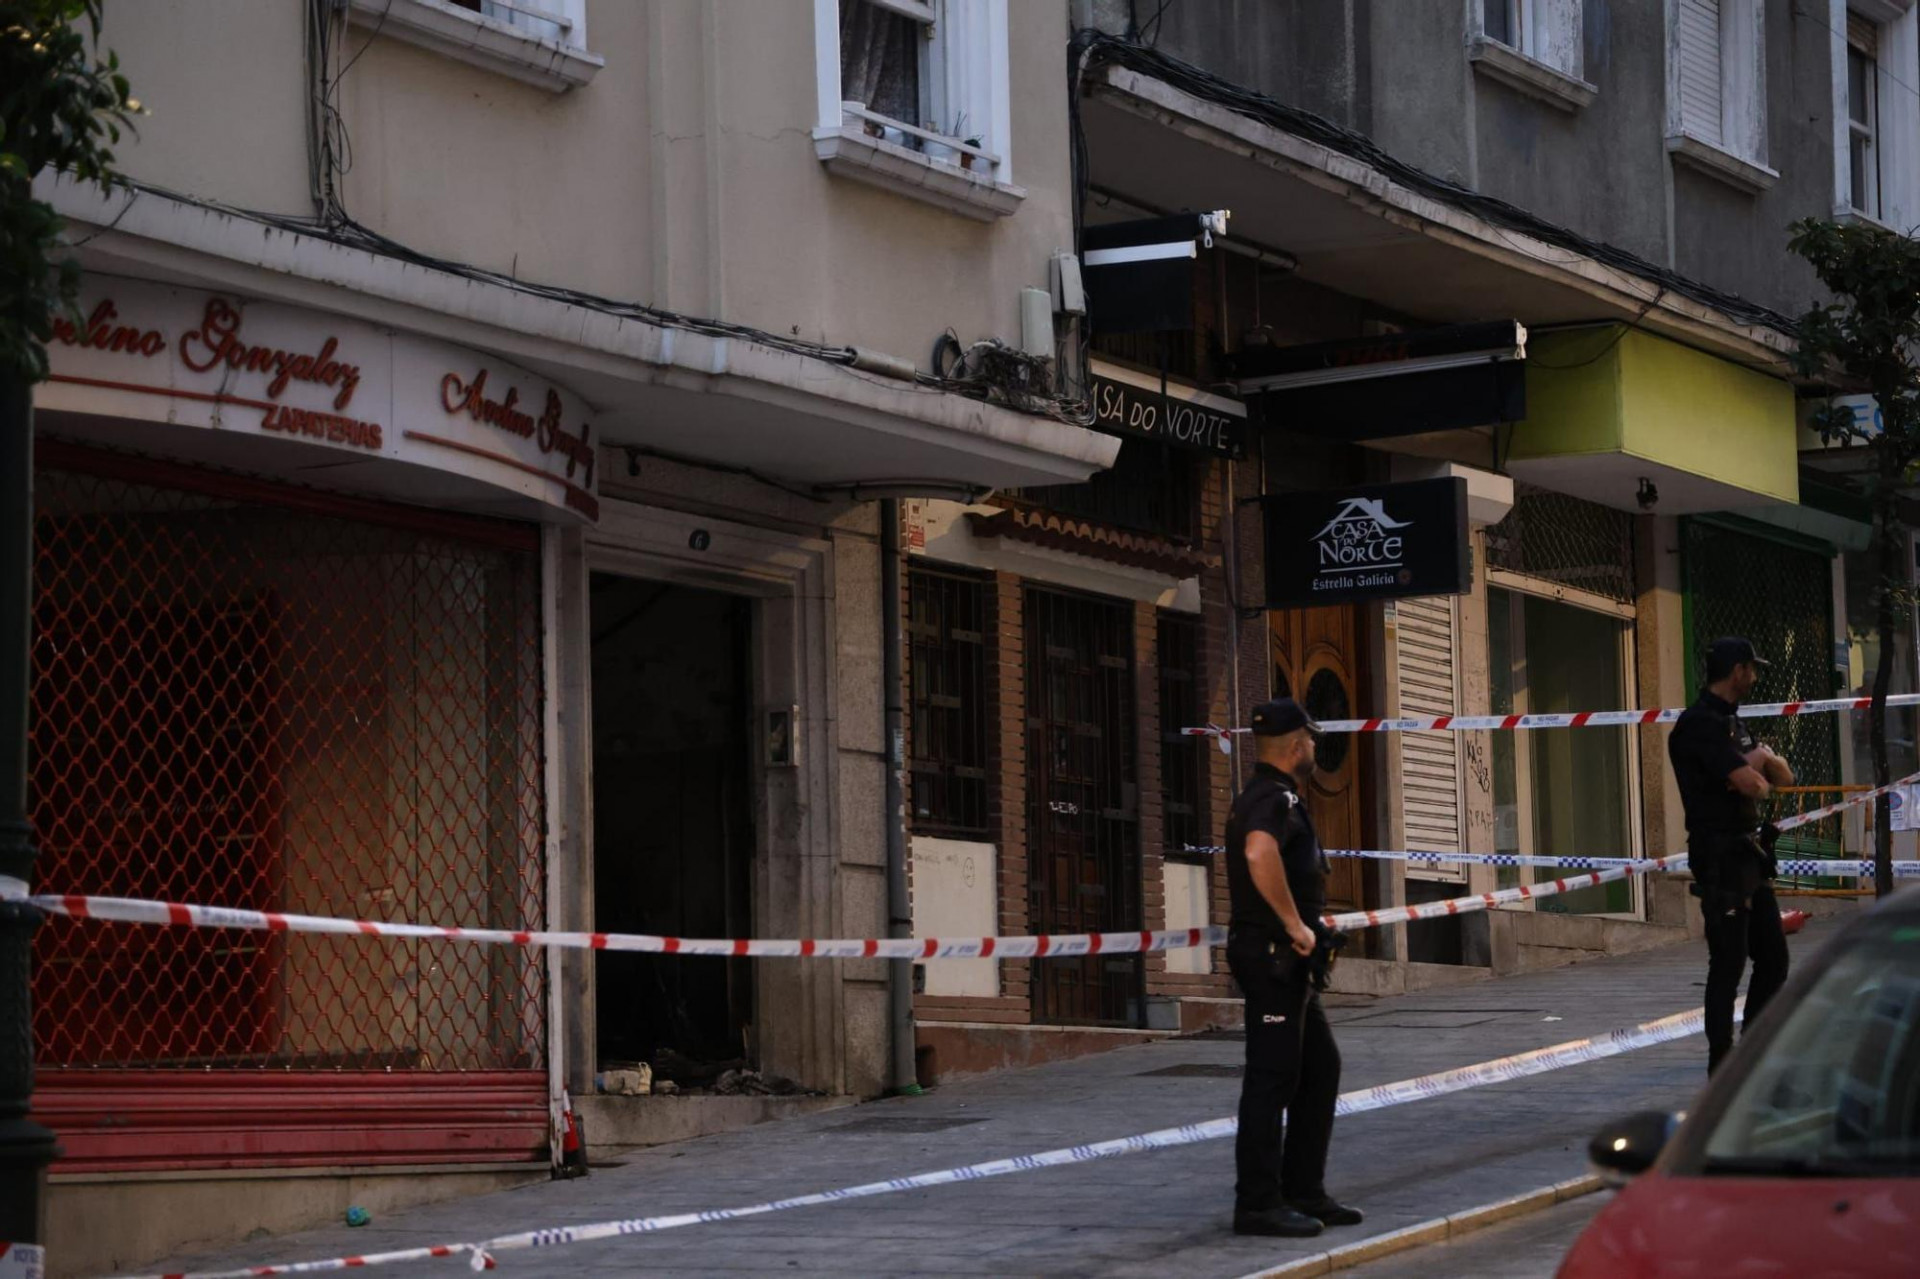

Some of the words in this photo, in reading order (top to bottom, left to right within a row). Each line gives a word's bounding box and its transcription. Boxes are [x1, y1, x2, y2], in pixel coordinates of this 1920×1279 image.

[1129, 401, 1157, 432] DO
[1160, 400, 1231, 451] NORTE
[1330, 520, 1387, 541] CASA
[1318, 536, 1404, 565] NORTE
[1343, 537, 1357, 546] DO
[1312, 575, 1354, 591] Estrella
[1356, 574, 1395, 587] Galicia
